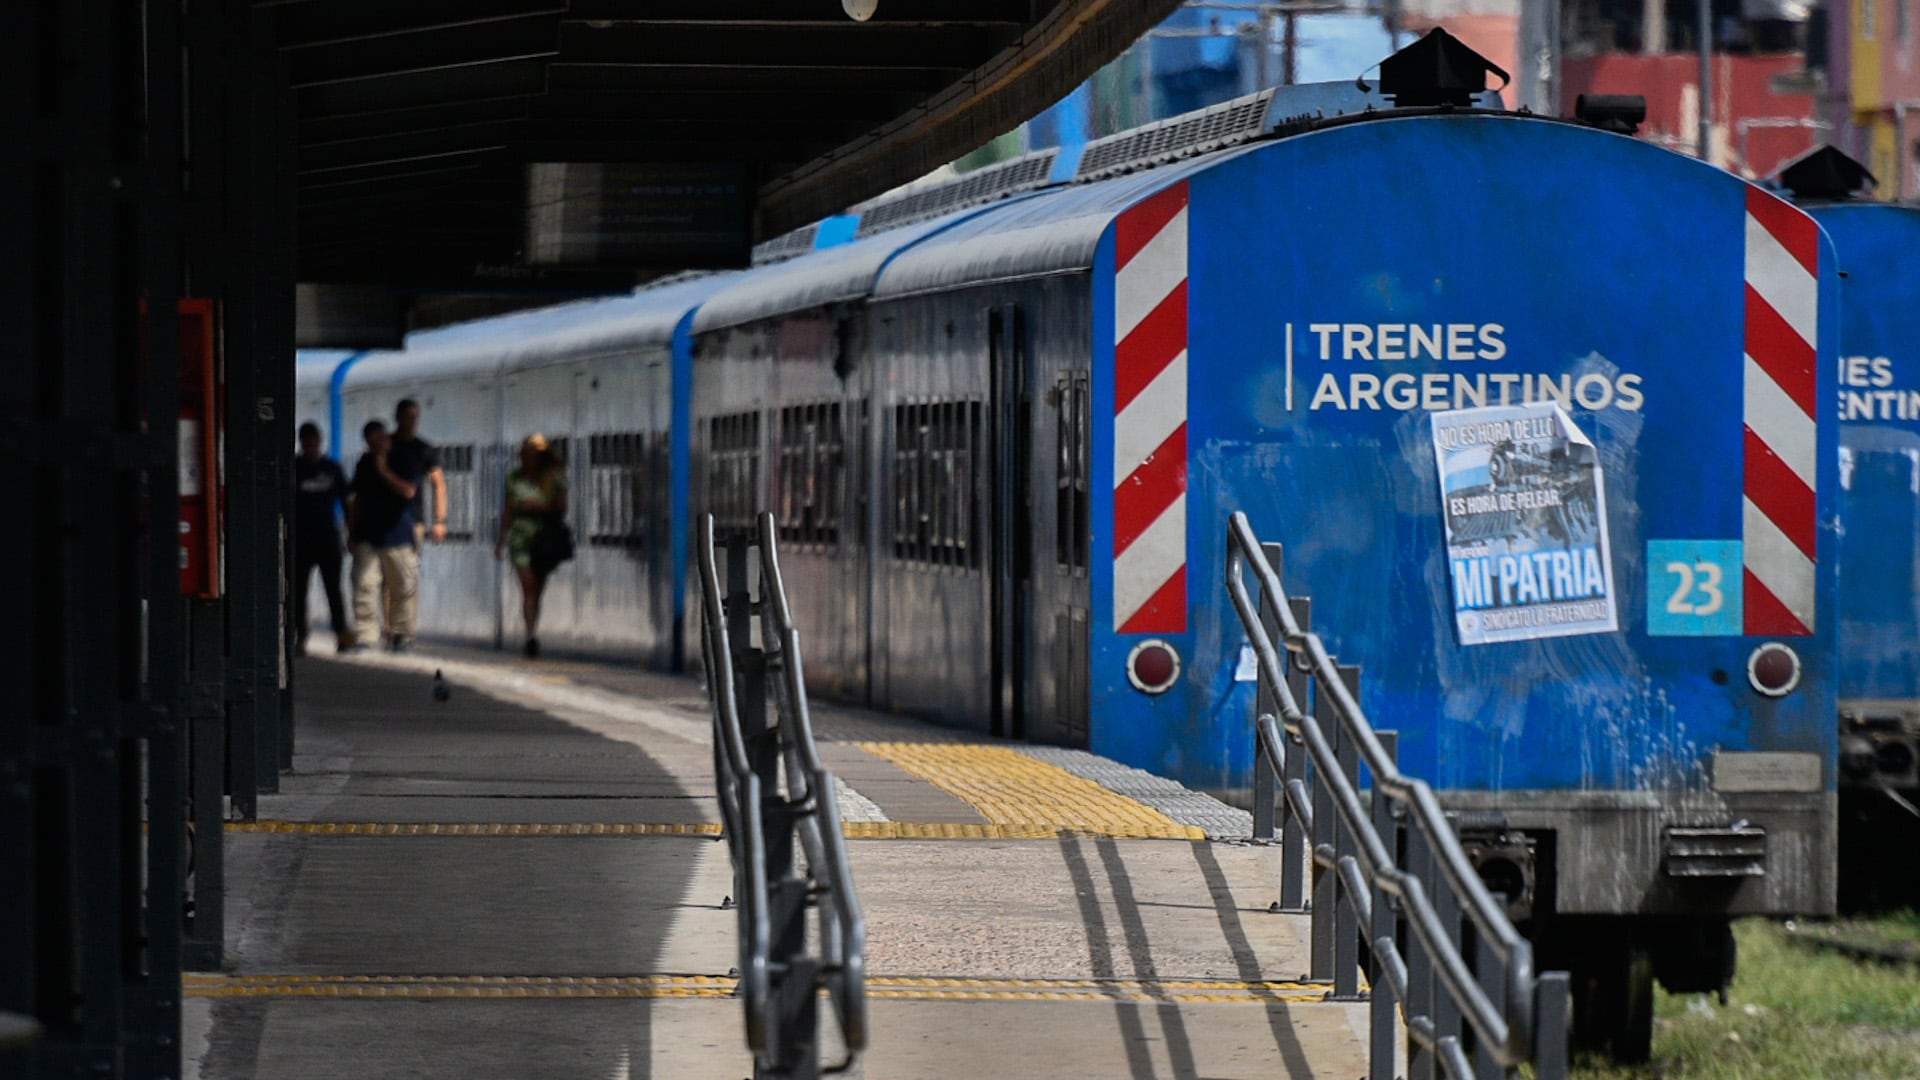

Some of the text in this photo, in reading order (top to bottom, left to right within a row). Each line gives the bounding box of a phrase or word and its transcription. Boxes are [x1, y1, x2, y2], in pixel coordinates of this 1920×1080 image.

[1310, 323, 1506, 361] TRENES
[1309, 373, 1644, 411] ARGENTINOS
[1439, 426, 1457, 447] NO
[1460, 424, 1476, 446] ES
[1478, 421, 1512, 444] HORA
[1514, 418, 1530, 440] DE
[1450, 497, 1466, 516] ES
[1467, 495, 1498, 514] HORA
[1500, 493, 1516, 511] DE
[1454, 548, 1605, 607] MI PATRIA
[1666, 562, 1723, 616] 23
